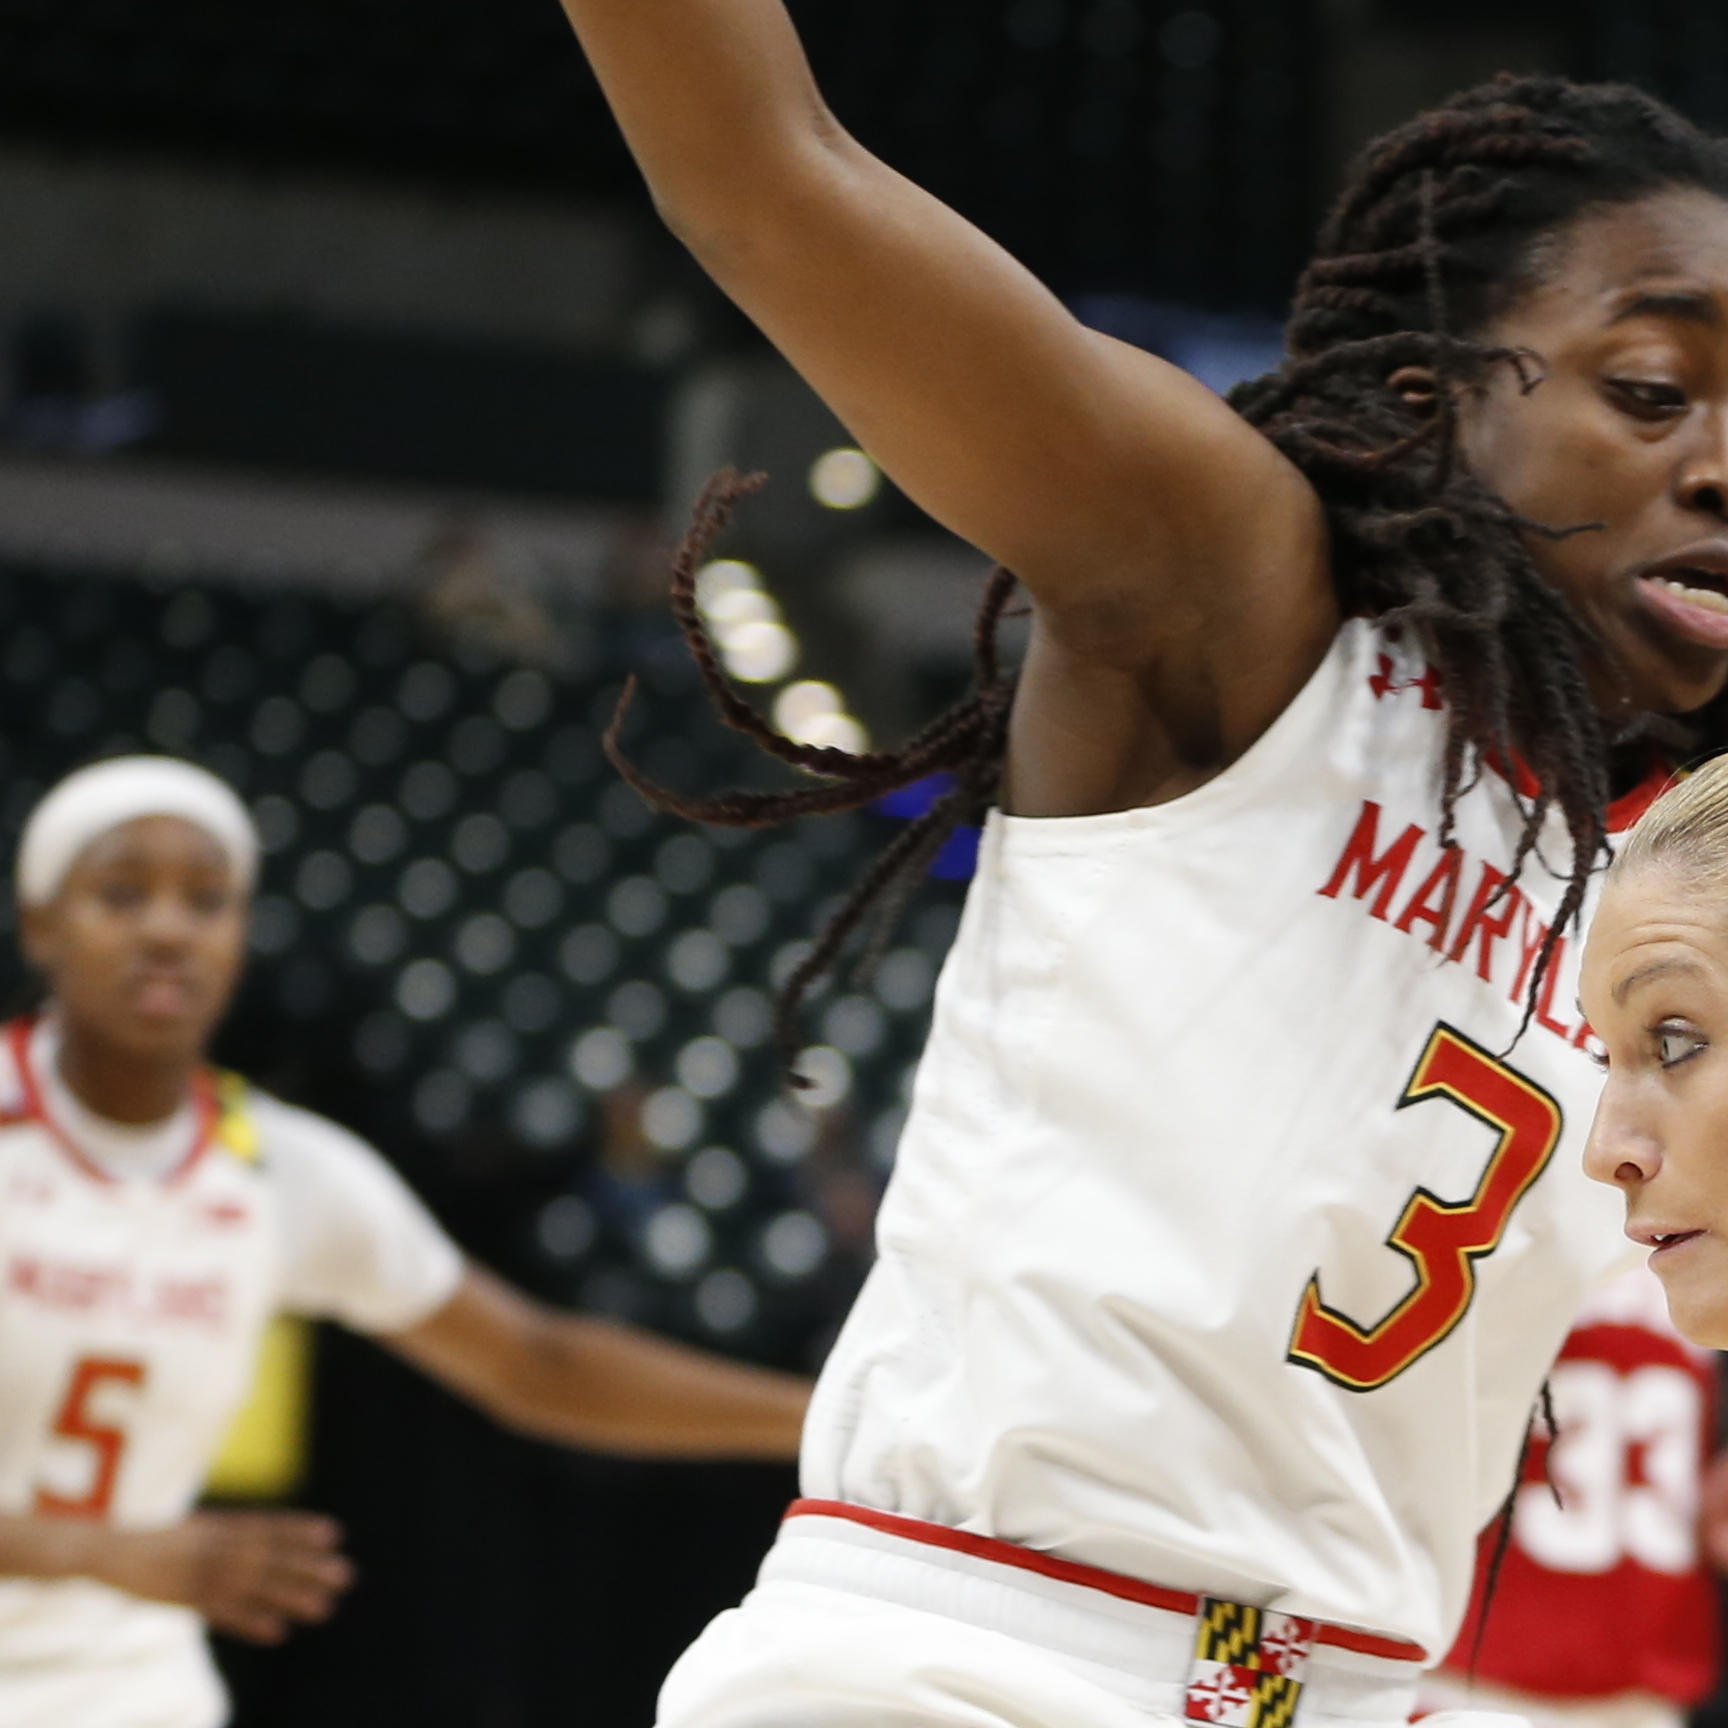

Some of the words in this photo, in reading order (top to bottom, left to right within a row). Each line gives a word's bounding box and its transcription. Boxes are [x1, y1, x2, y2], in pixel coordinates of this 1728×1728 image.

[1287, 1021, 1563, 1393] 3
[34, 1354, 148, 1520] 5
[1508, 1358, 1704, 1575] 33
